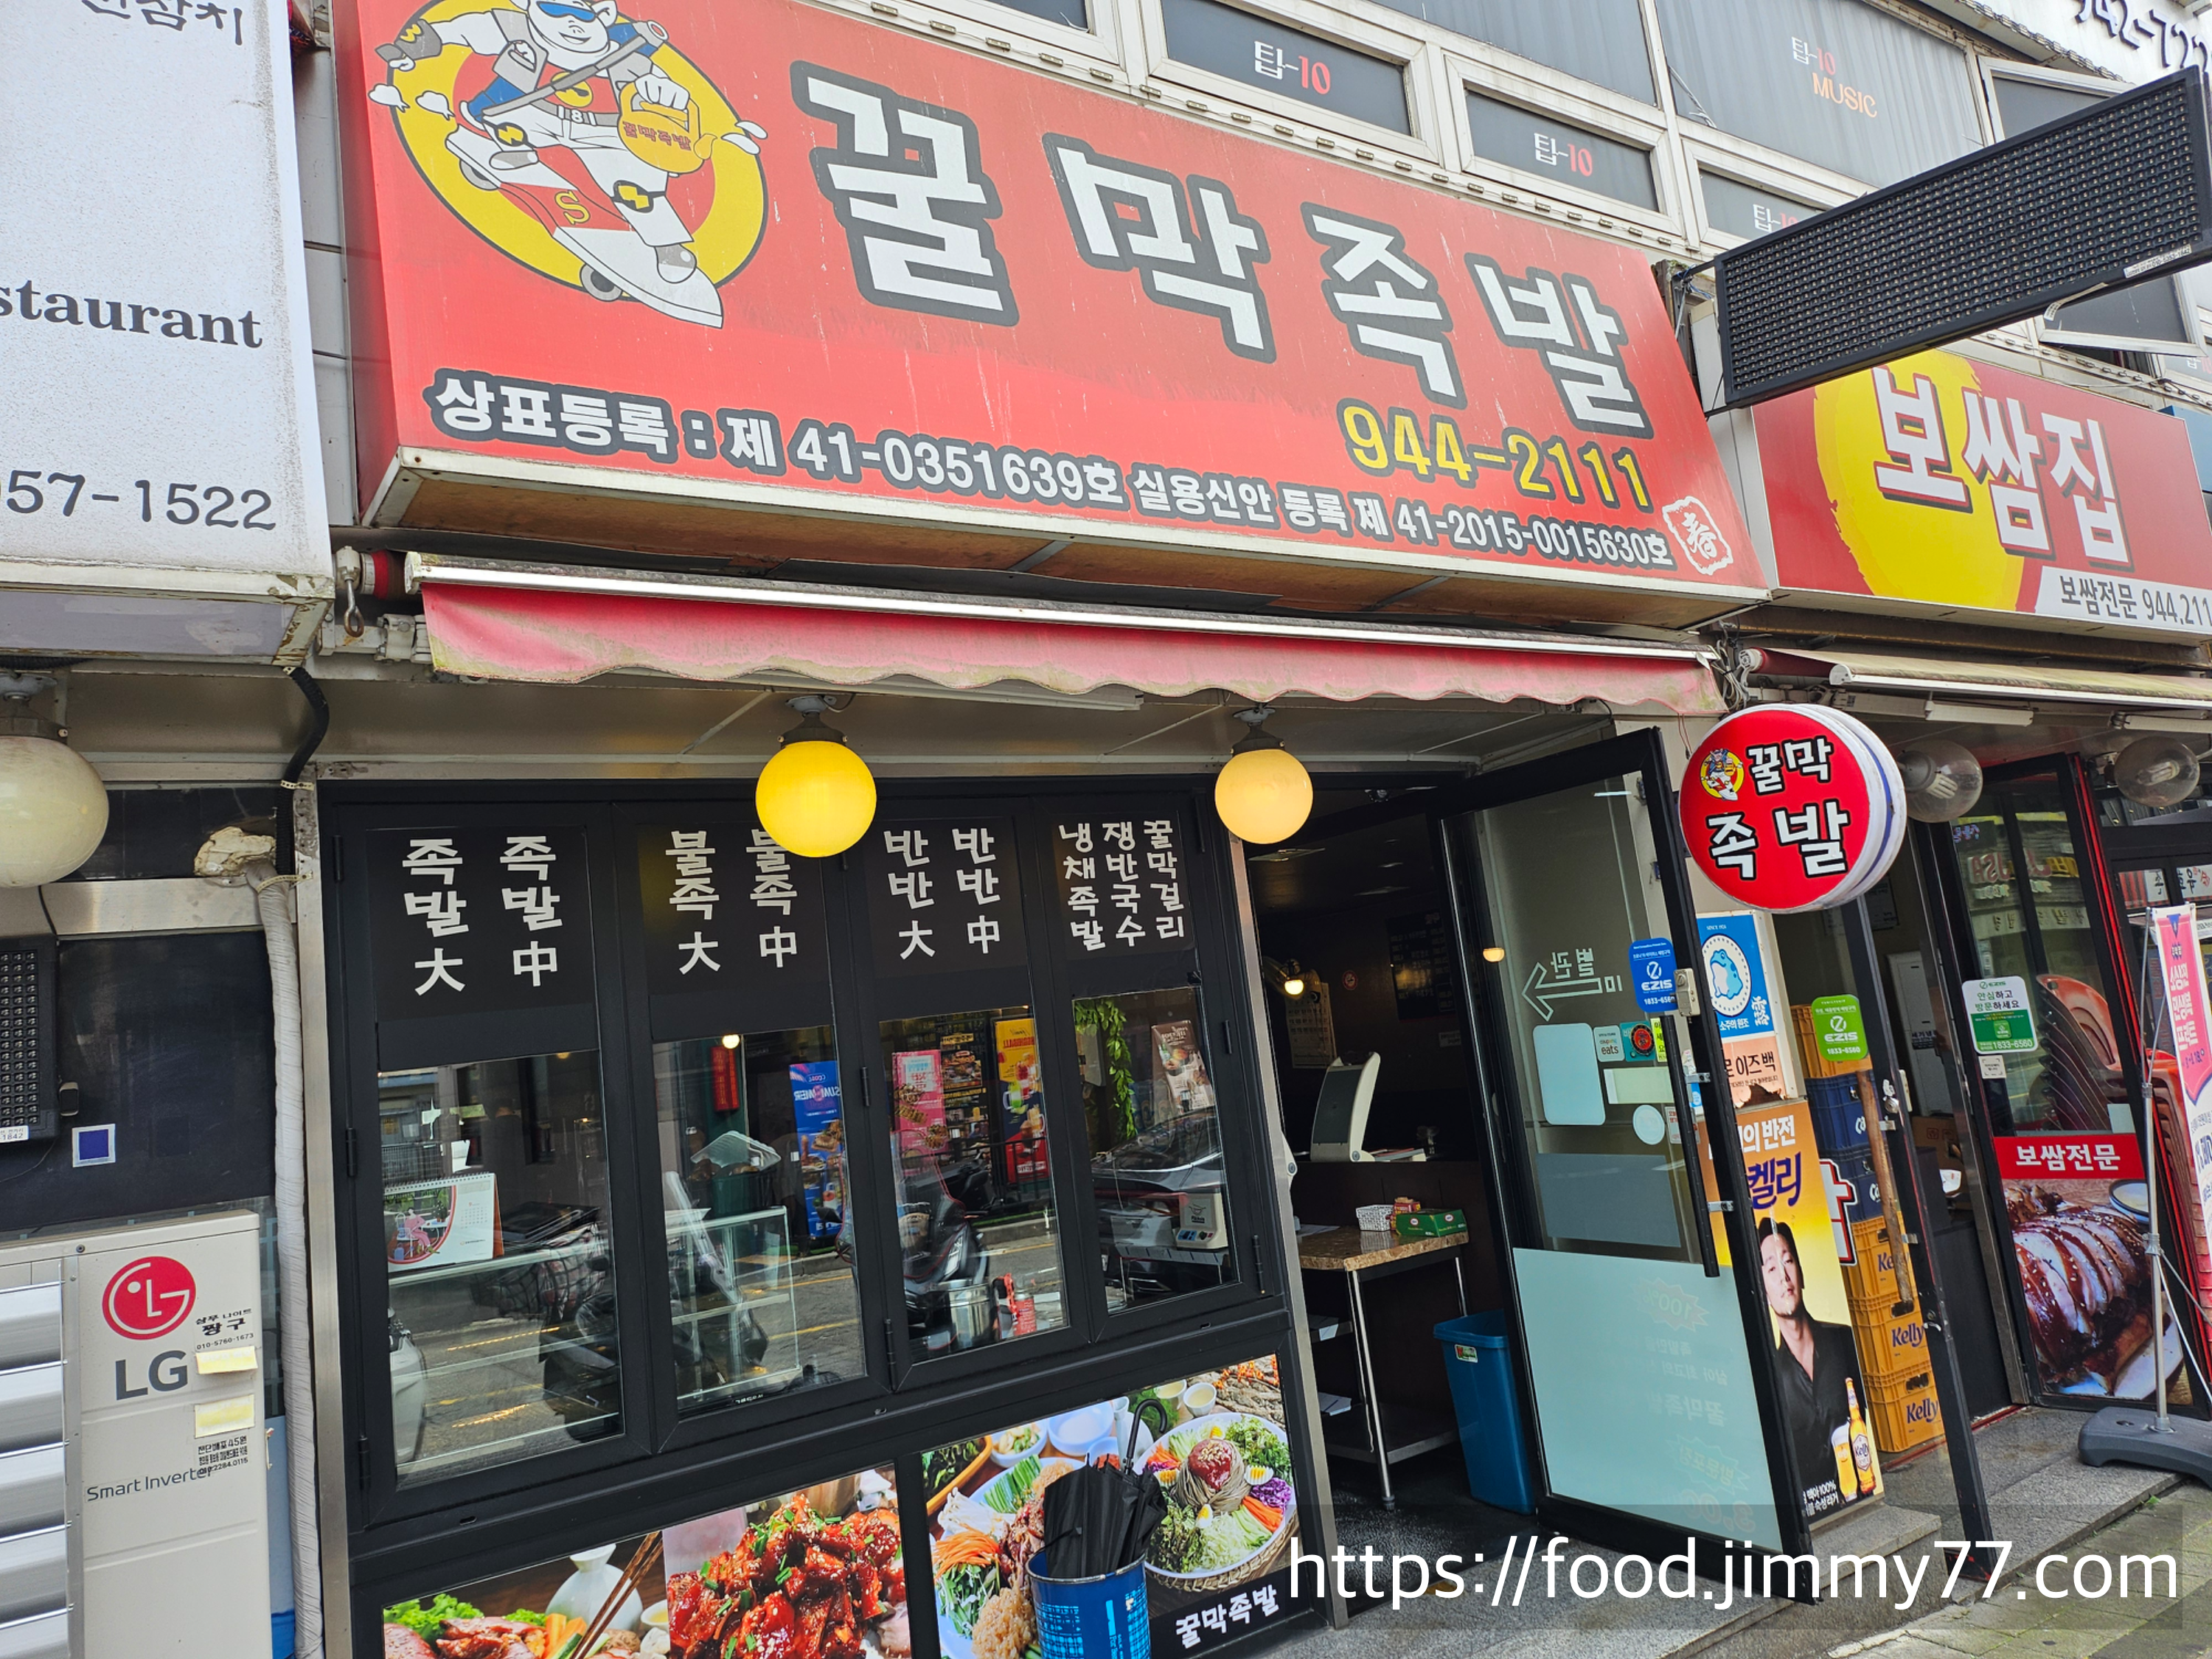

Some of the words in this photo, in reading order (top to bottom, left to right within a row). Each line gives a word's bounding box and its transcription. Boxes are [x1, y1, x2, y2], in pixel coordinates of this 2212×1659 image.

[1254, 40, 1330, 95] 탑-10
[1791, 37, 1836, 75] 탑-10
[1812, 72, 1877, 118] MUSIC
[1534, 132, 1593, 177] 탑-10
[436, 378, 669, 455] 상표등록
[726, 416, 777, 468] 제
[1133, 467, 1276, 524] 실용신안
[1284, 487, 1348, 532] 등록
[1354, 497, 1389, 537] 제
[1343, 406, 1649, 508] 944-2111
[1873, 367, 2129, 563] 보쌈집
[2059, 575, 2138, 619] 보쌈전문
[1747, 738, 1832, 793] 꿀막
[1708, 801, 1848, 878] 족발
[402, 838, 470, 937] 족발
[499, 835, 563, 931] 족발
[665, 830, 720, 920] 불족
[883, 830, 934, 910] 반반
[952, 828, 1001, 905] 반반
[1059, 822, 1105, 951] 냉채족발
[1102, 821, 1146, 947] 쟁반국수
[1143, 820, 1185, 939] 꿀막걸리
[678, 931, 721, 975] 大
[759, 926, 798, 968] 中
[898, 920, 936, 960] 大
[967, 915, 1001, 954] 中
[414, 947, 466, 996] 大
[512, 940, 557, 987] 中
[1641, 979, 1673, 991] EZIS
[1975, 1000, 2020, 1012] 방문하세요
[1977, 990, 2014, 1002] 안심하고
[1601, 1045, 1619, 1055] eats
[1824, 1032, 1858, 1043] EZIS
[1761, 1115, 1796, 1150] 반전
[1747, 1151, 1801, 1210] 켈리
[2015, 1143, 2121, 1171] 보쌈전문
[1892, 1323, 1924, 1348] Kelly
[115, 1350, 188, 1401] LG
[1907, 1397, 1938, 1424] Kelly
[86, 1480, 142, 1503] Smart
[145, 1464, 215, 1491] Inverter
[1176, 1584, 1279, 1649] 꿀막족발
